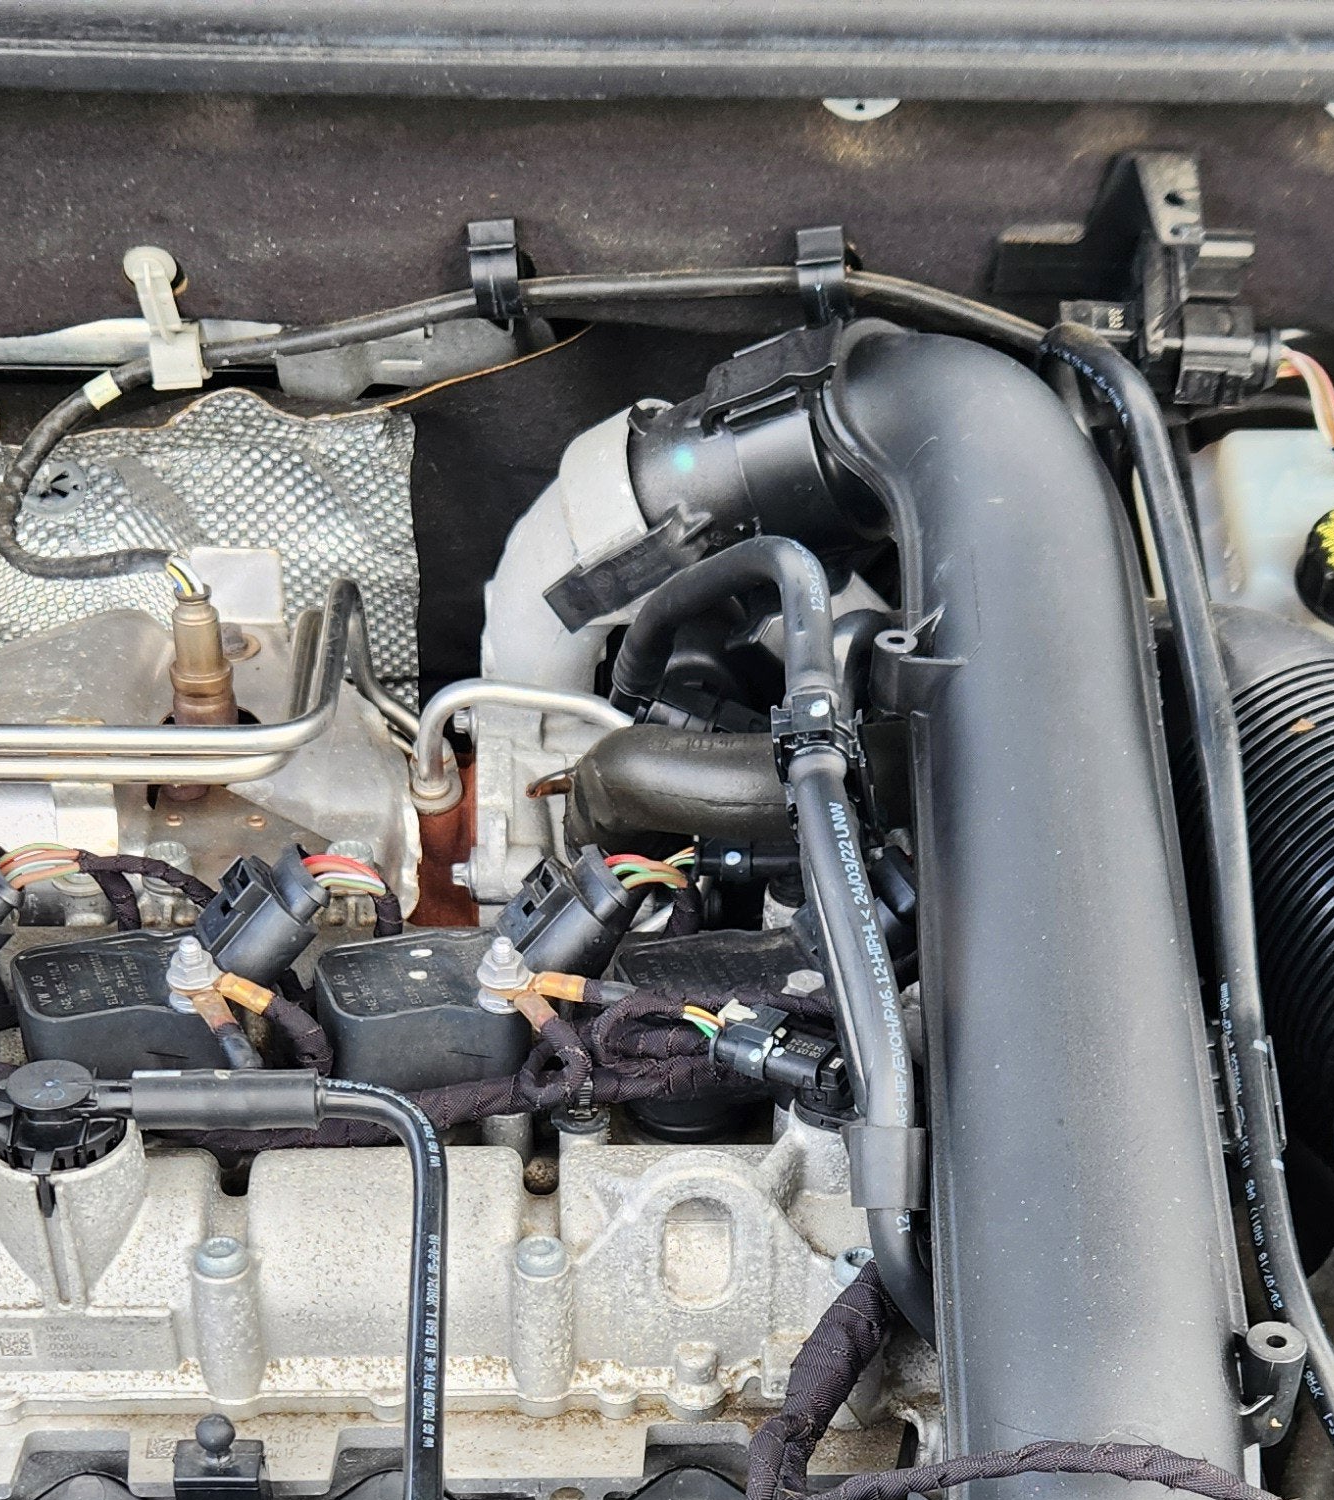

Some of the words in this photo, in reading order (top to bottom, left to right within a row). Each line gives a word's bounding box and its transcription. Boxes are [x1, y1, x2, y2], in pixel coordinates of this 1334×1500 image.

[838, 841, 869, 904] 24/03/22
[30, 975, 47, 988] AG
[35, 993, 53, 1006] VW
